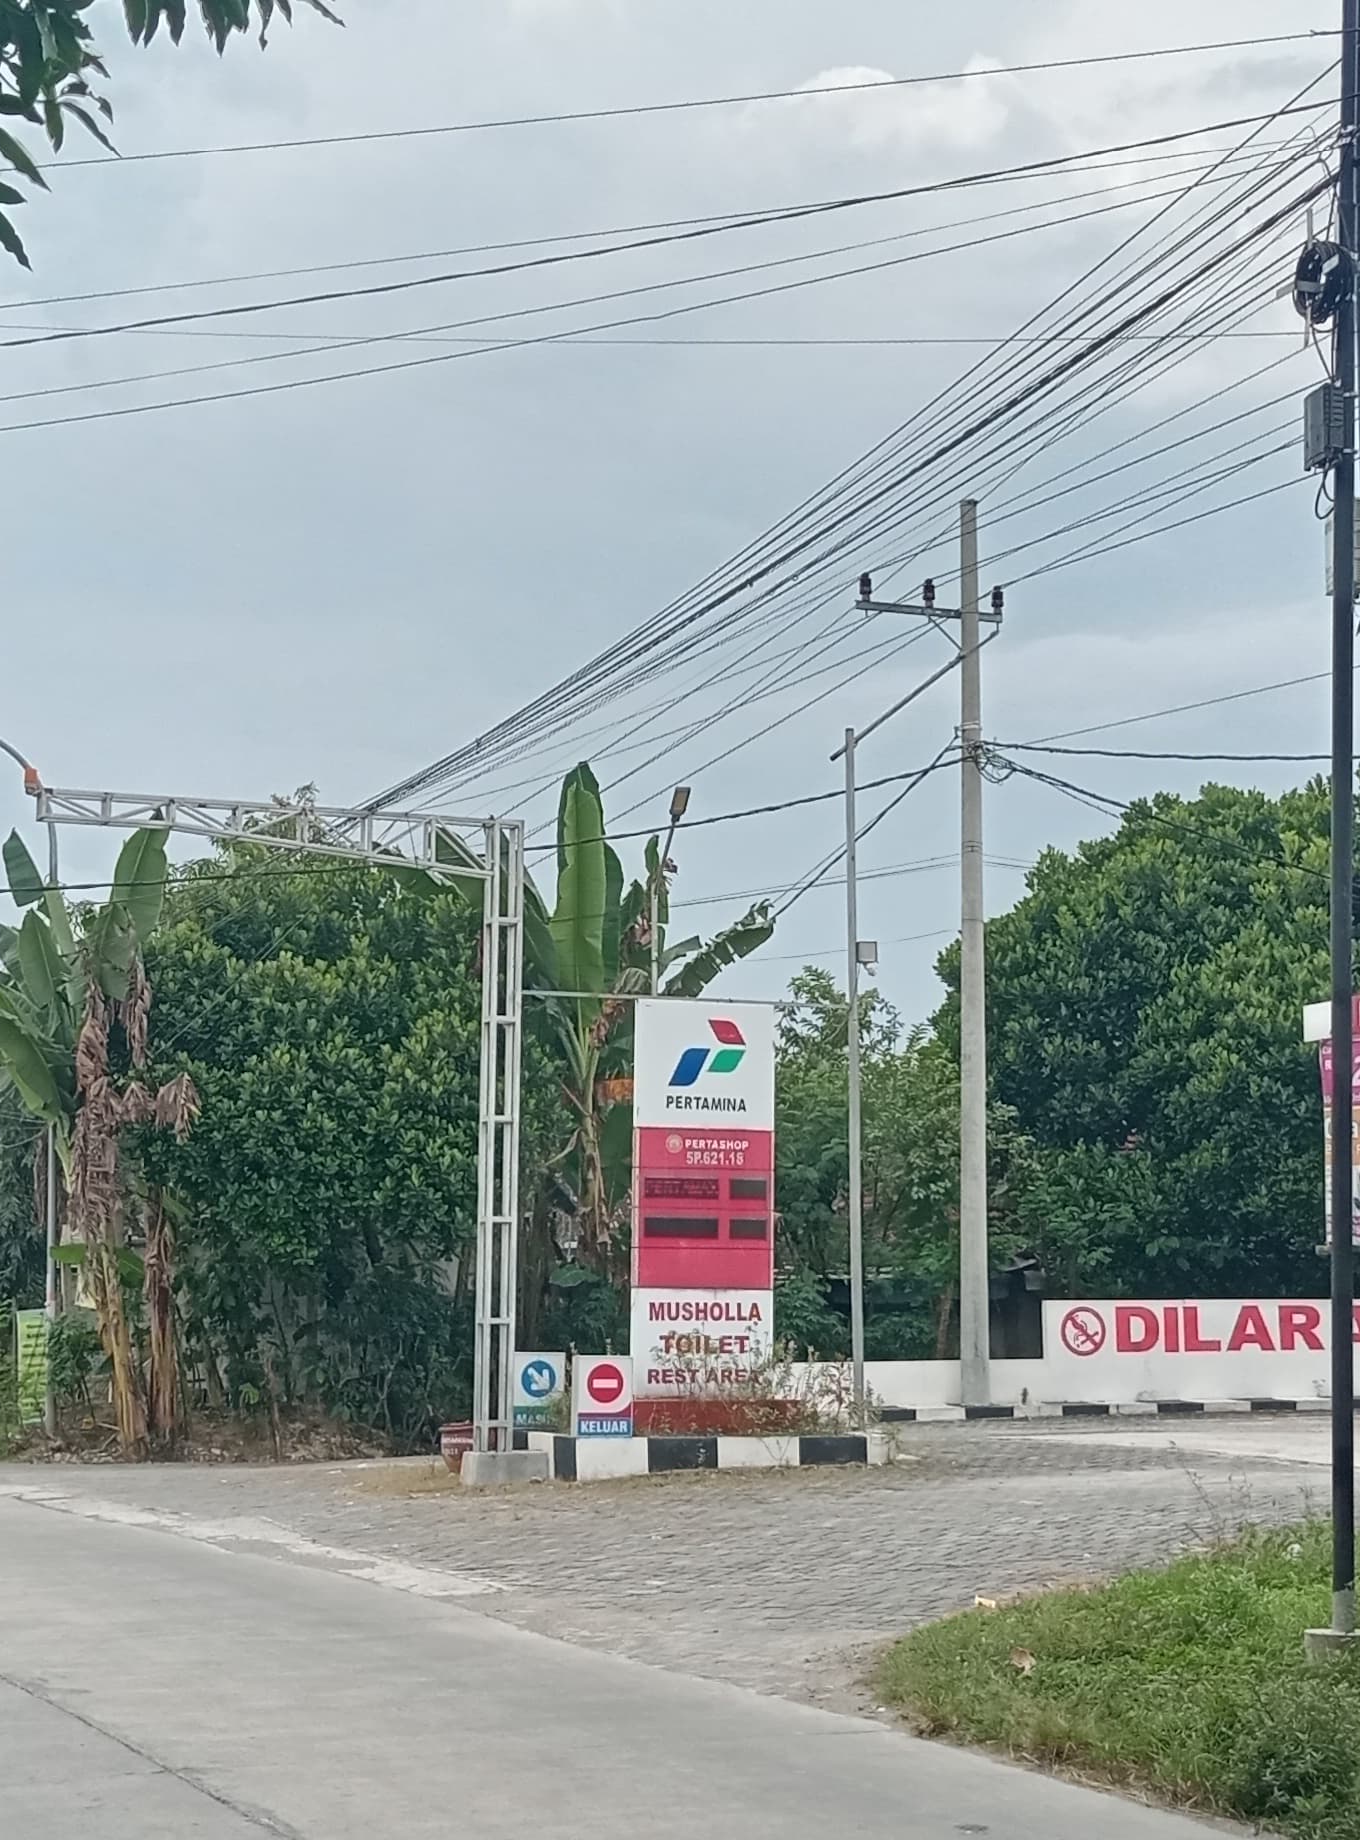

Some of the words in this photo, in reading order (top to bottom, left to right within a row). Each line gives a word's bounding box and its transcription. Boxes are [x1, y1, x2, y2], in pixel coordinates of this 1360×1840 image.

[666, 1095, 747, 1113] PERTAMINA
[685, 1139, 749, 1150] PERTASHOP
[649, 1302, 762, 1322] MUSHOLLA
[659, 1335, 750, 1354] TOILET
[647, 1369, 699, 1384] REST
[580, 1420, 629, 1435] KELUAR
